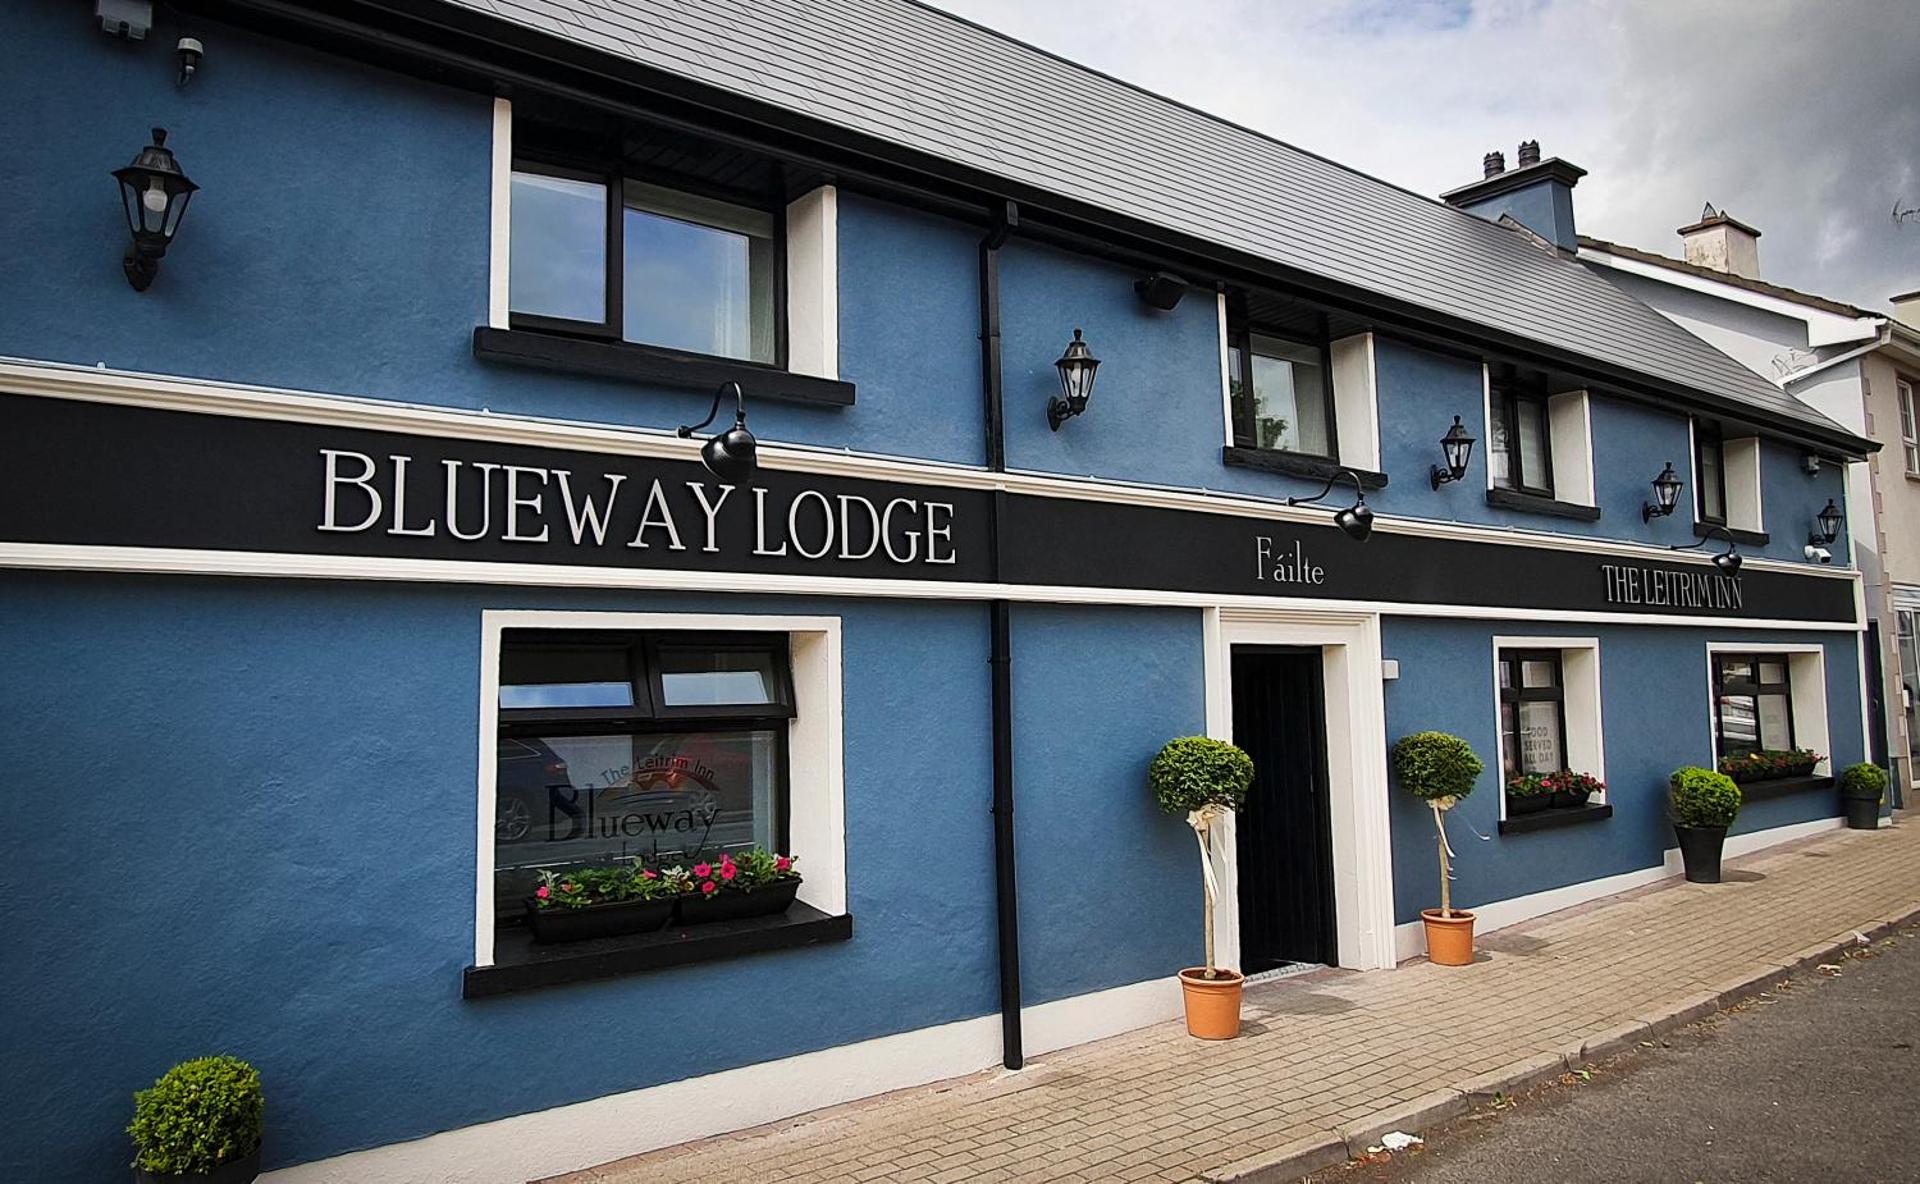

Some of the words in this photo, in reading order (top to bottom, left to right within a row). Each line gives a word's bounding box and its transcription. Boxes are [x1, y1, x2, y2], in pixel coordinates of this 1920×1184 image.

[317, 449, 736, 552] BLUEWAY
[752, 487, 956, 564] LODGE
[1256, 536, 1325, 585] Fáilte
[1602, 565, 1641, 604] THE
[1643, 569, 1713, 608] LEITRIM
[1714, 576, 1743, 609] INN
[600, 765, 630, 786] The
[635, 753, 689, 770] Leitrim
[694, 759, 715, 781] Inn
[546, 782, 722, 859] Blueway
